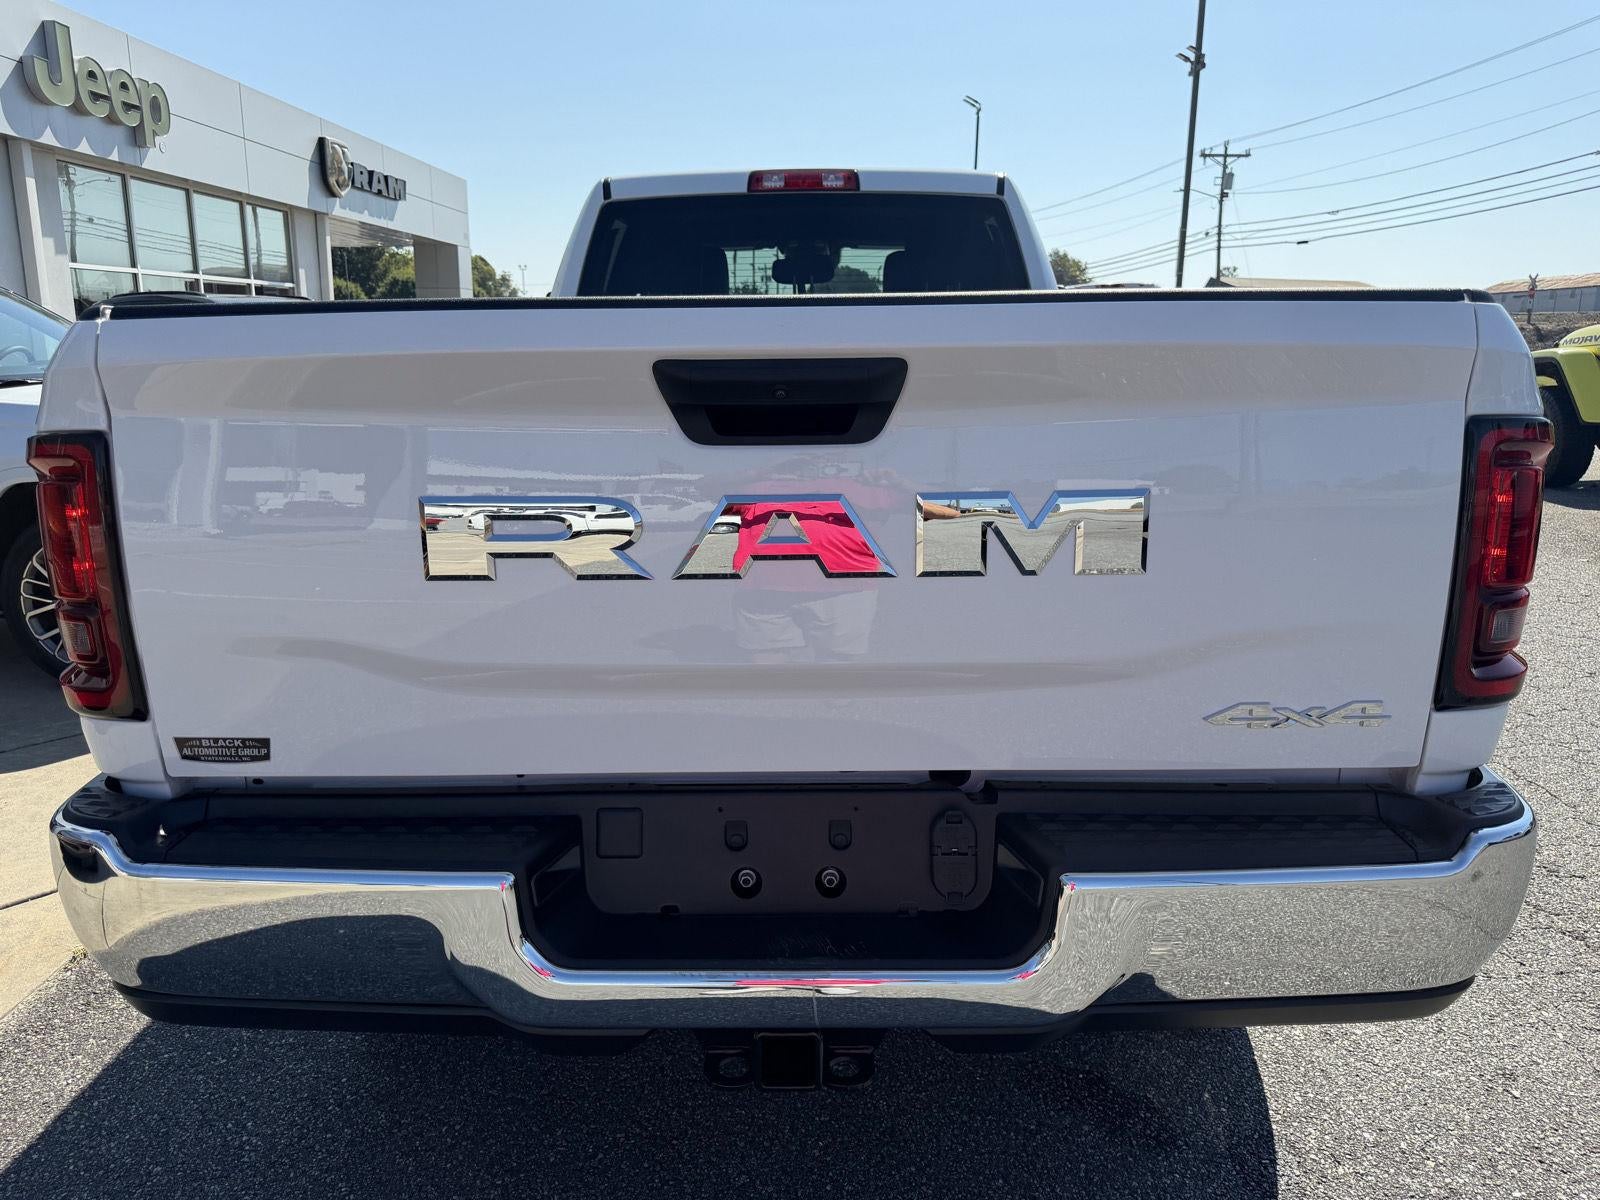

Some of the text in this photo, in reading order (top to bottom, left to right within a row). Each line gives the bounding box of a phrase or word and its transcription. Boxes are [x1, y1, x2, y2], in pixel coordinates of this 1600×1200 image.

[21, 20, 171, 149] Jeep
[351, 162, 407, 201] RAM
[418, 487, 1152, 582] RAM
[182, 747, 268, 756] AUTOMOTIVE GROUP
[201, 739, 243, 747] BLACK
